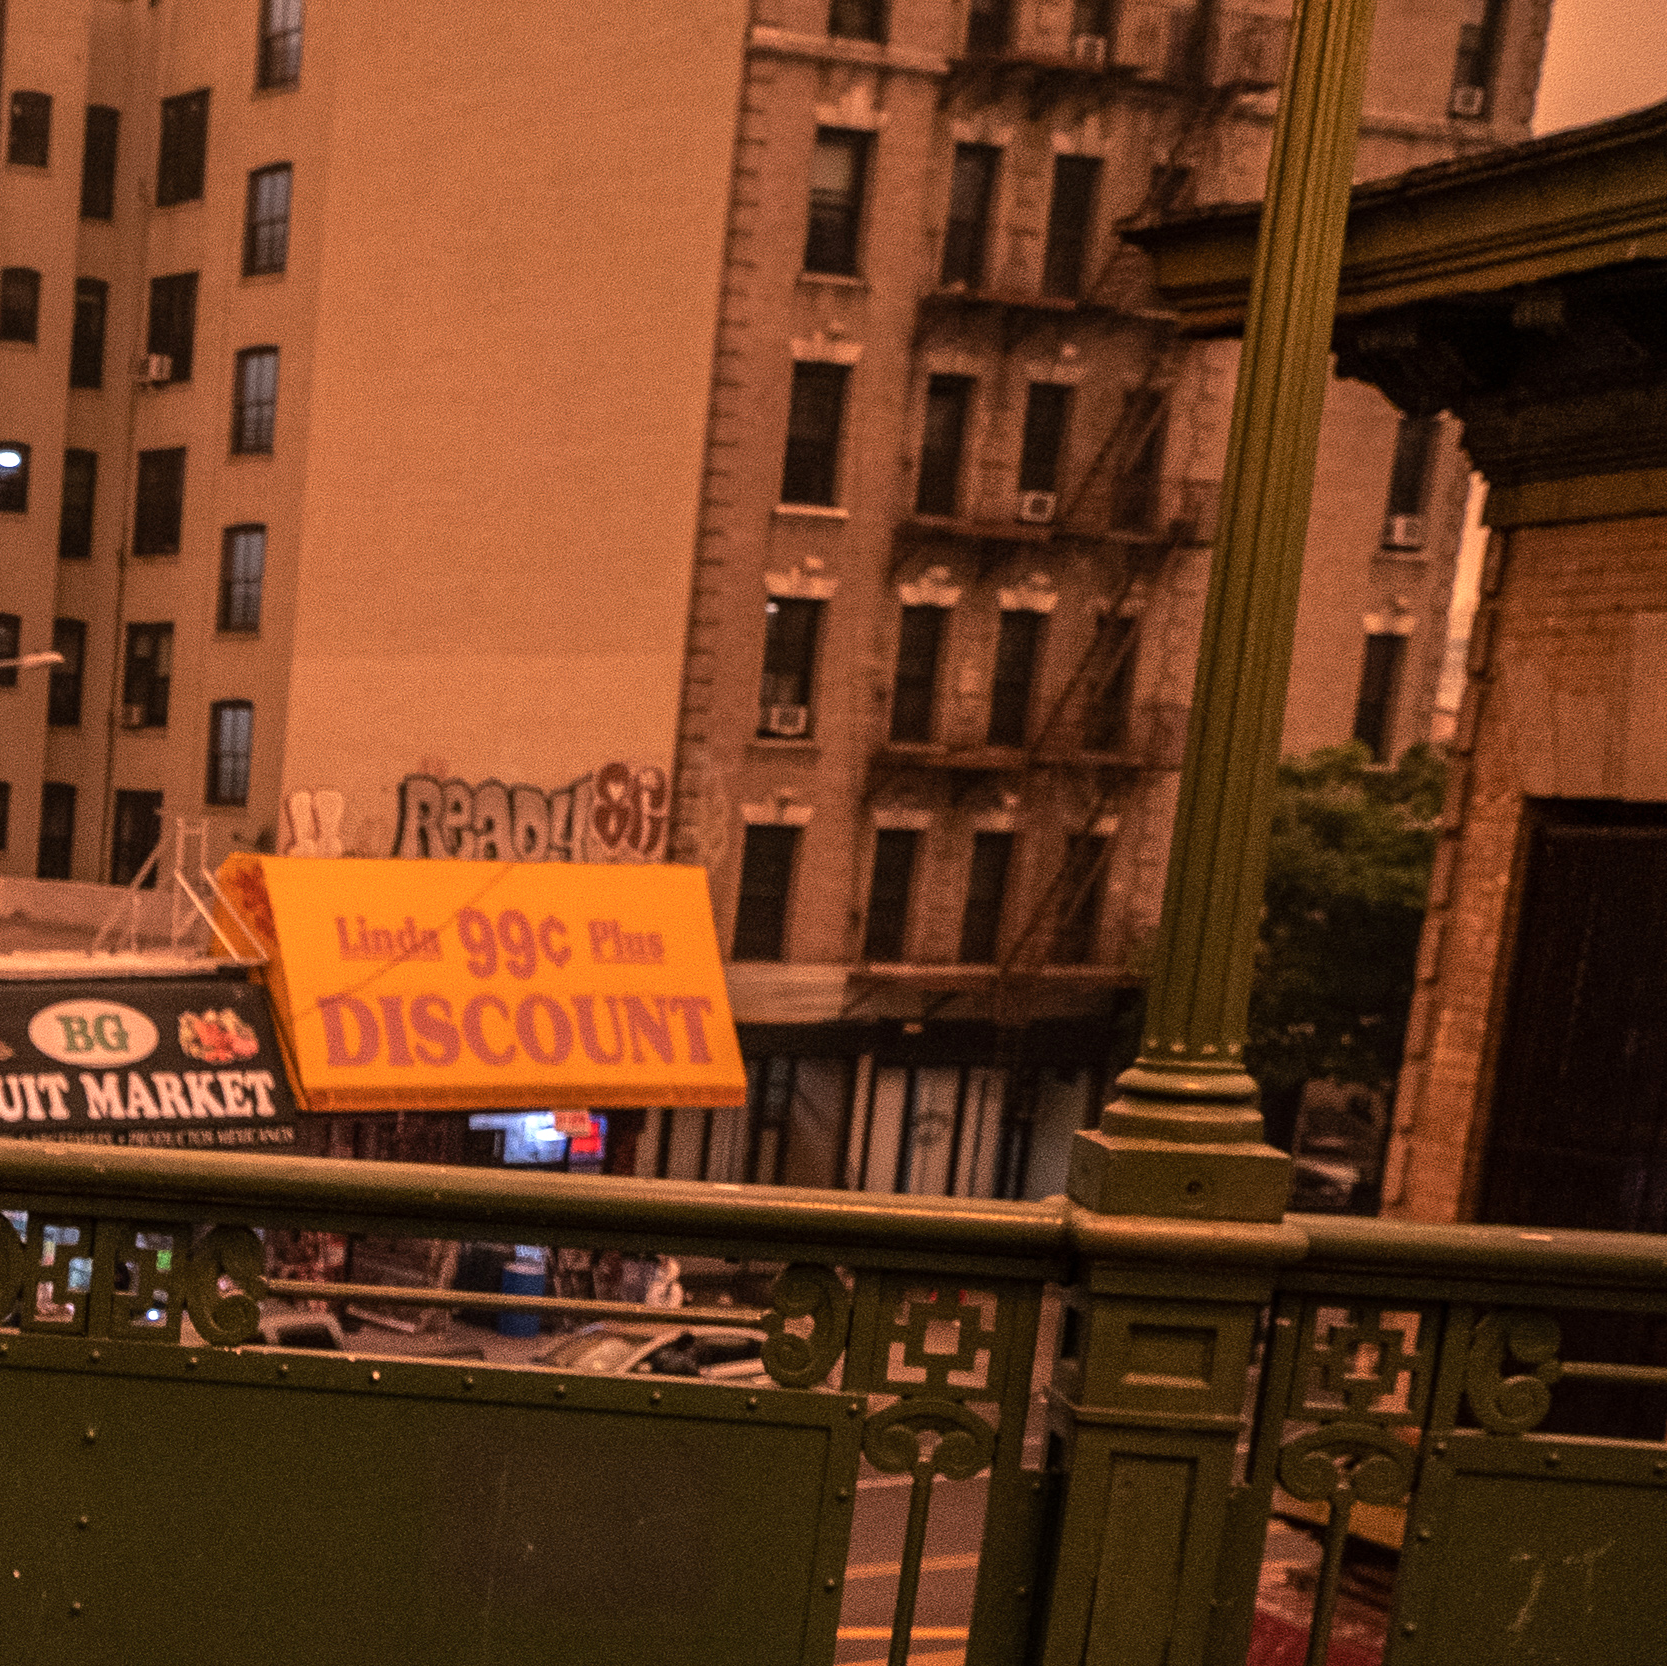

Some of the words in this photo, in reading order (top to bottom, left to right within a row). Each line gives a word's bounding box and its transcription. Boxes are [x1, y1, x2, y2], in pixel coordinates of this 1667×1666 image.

[335, 915, 440, 963] Linda
[458, 907, 573, 981] 99¢
[588, 919, 665, 964] Plus
[56, 1014, 129, 1053] BG
[318, 993, 714, 1068] DISCOUNT
[79, 1070, 276, 1120] MARKET
